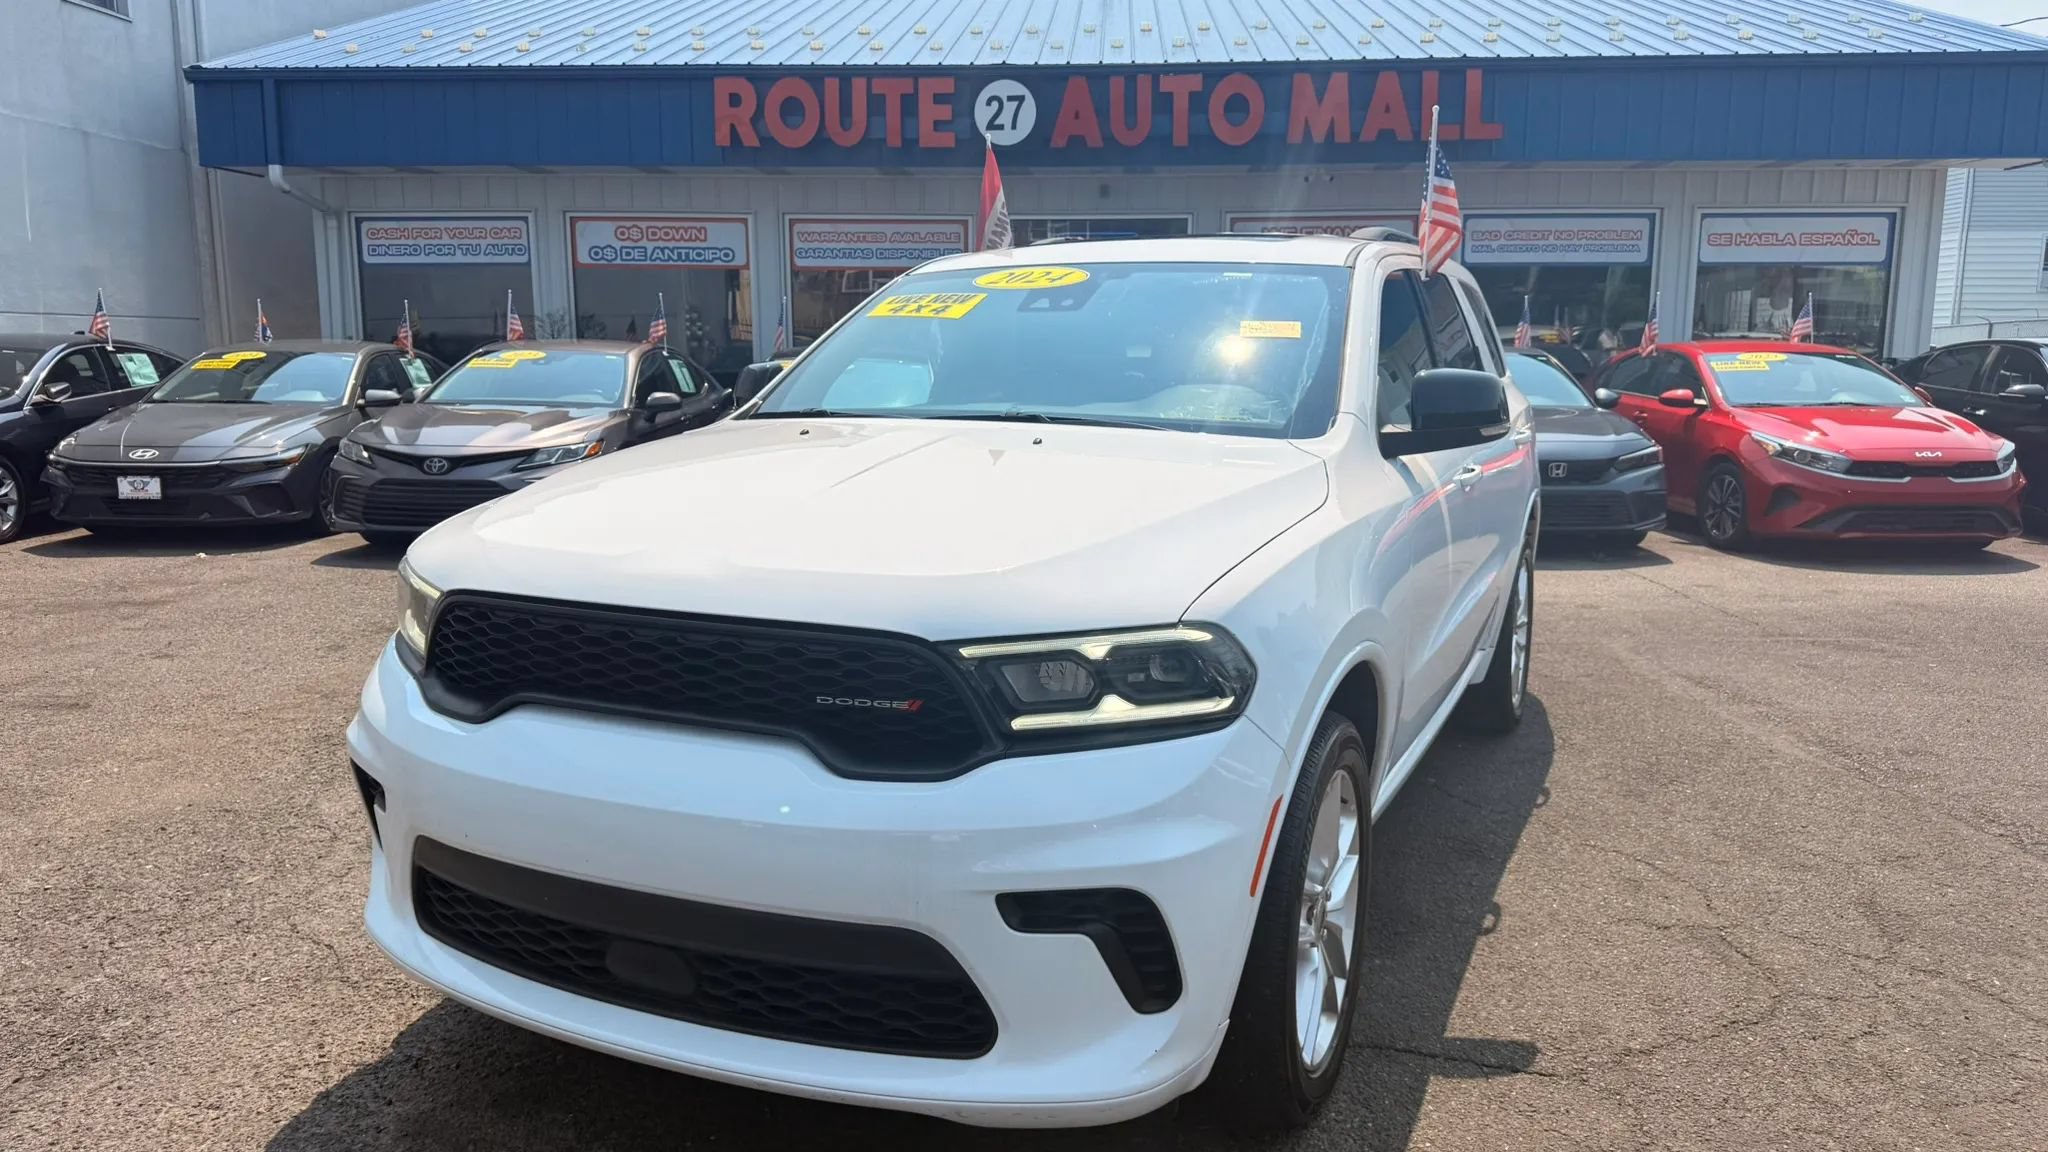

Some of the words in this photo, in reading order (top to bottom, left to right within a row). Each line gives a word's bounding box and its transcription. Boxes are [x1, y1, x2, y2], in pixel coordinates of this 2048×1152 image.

[713, 76, 956, 148] ROUTE
[985, 95, 1026, 131] 27
[1050, 72, 1265, 148] AUTO
[1287, 68, 1504, 144] MALL
[367, 227, 409, 240] CASH
[413, 227, 442, 240] FOR
[445, 227, 488, 240] YOUR
[489, 227, 522, 240] CAR
[646, 226, 707, 242] DOWN
[798, 231, 887, 244] WARRANTIES
[889, 231, 961, 244] AVAILABLE
[1471, 230, 1502, 241] BAD
[1503, 230, 1552, 241] CREDIT
[1553, 230, 1575, 241] NO
[1577, 229, 1643, 241] PROBLEM
[1707, 232, 1734, 246] SE
[1735, 232, 1795, 246] HABLA
[1799, 229, 1880, 246] ESPAÑOL
[368, 243, 421, 256] DINERO
[424, 243, 455, 256] POR
[458, 243, 481, 256] TU
[483, 243, 527, 256] AUTO
[620, 246, 647, 262] DE
[651, 246, 735, 262] ANTICIPO
[795, 247, 874, 260] GARANTIAS
[986, 271, 1075, 285] 2024
[886, 294, 925, 305] LIKE
[927, 293, 978, 305] NEW
[816, 696, 909, 708] DODGE
